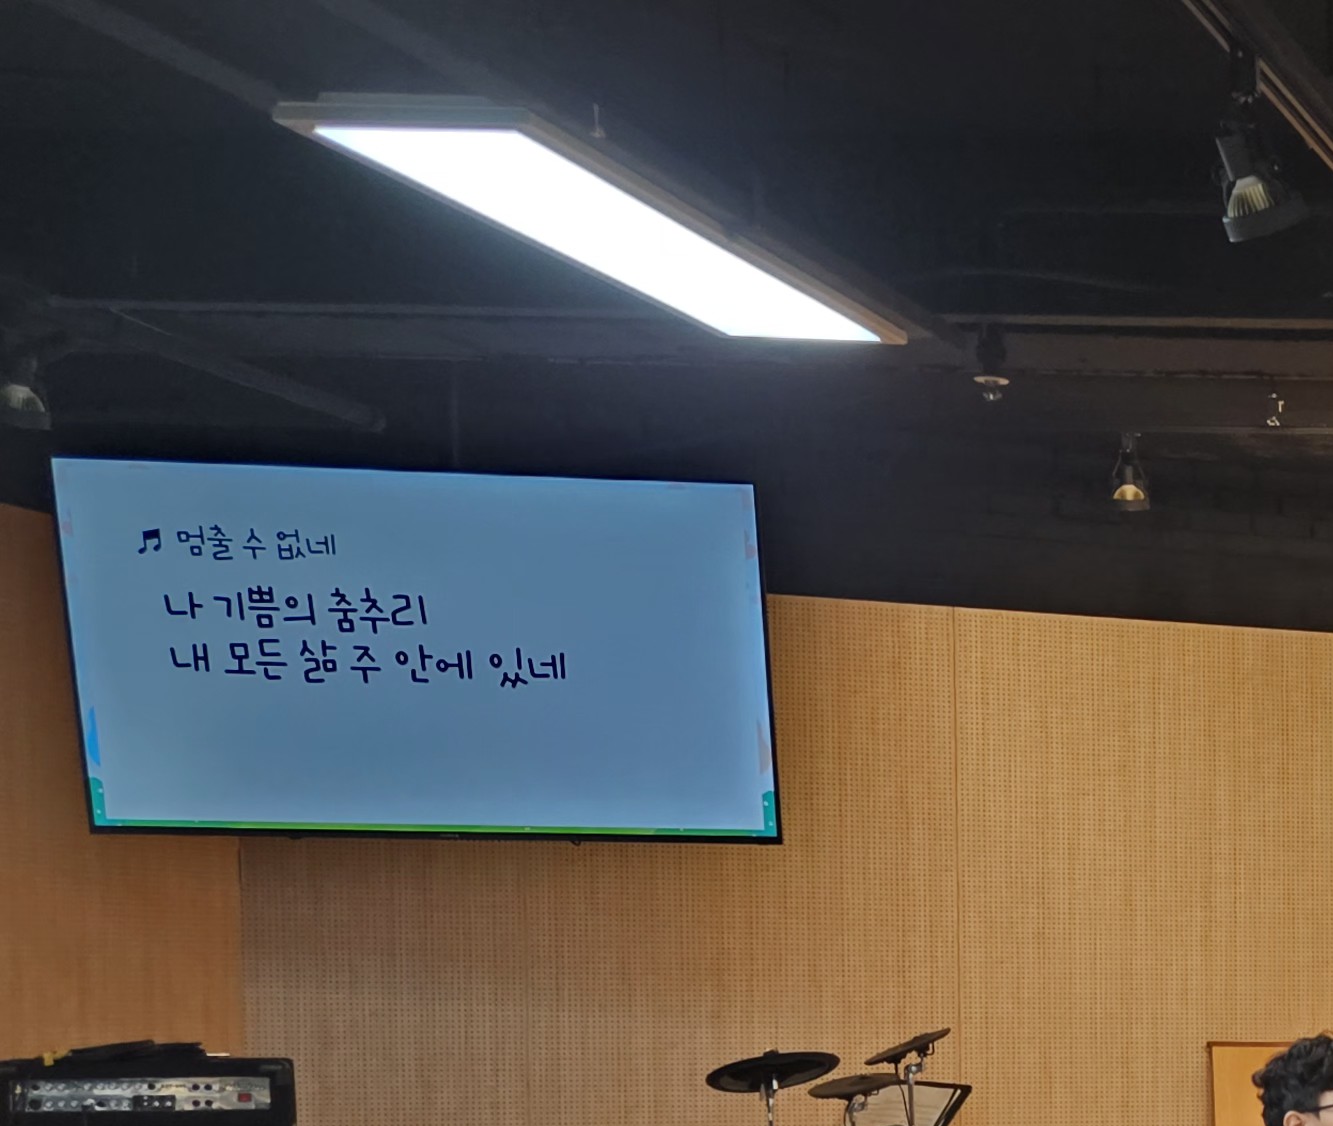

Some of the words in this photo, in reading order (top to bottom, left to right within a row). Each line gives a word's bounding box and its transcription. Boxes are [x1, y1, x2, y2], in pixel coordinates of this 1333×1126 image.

[176, 525, 234, 561] 멈출
[243, 527, 267, 560] 수
[276, 528, 337, 560] 없네
[164, 592, 203, 620] 나
[213, 585, 316, 629] 기쁨의
[328, 587, 428, 635] 춤추리
[169, 643, 210, 673] 내
[224, 638, 288, 681] 모든
[299, 639, 338, 684] 삶
[350, 645, 381, 684] 주
[395, 644, 473, 684] 안에
[489, 647, 567, 689] 있네
